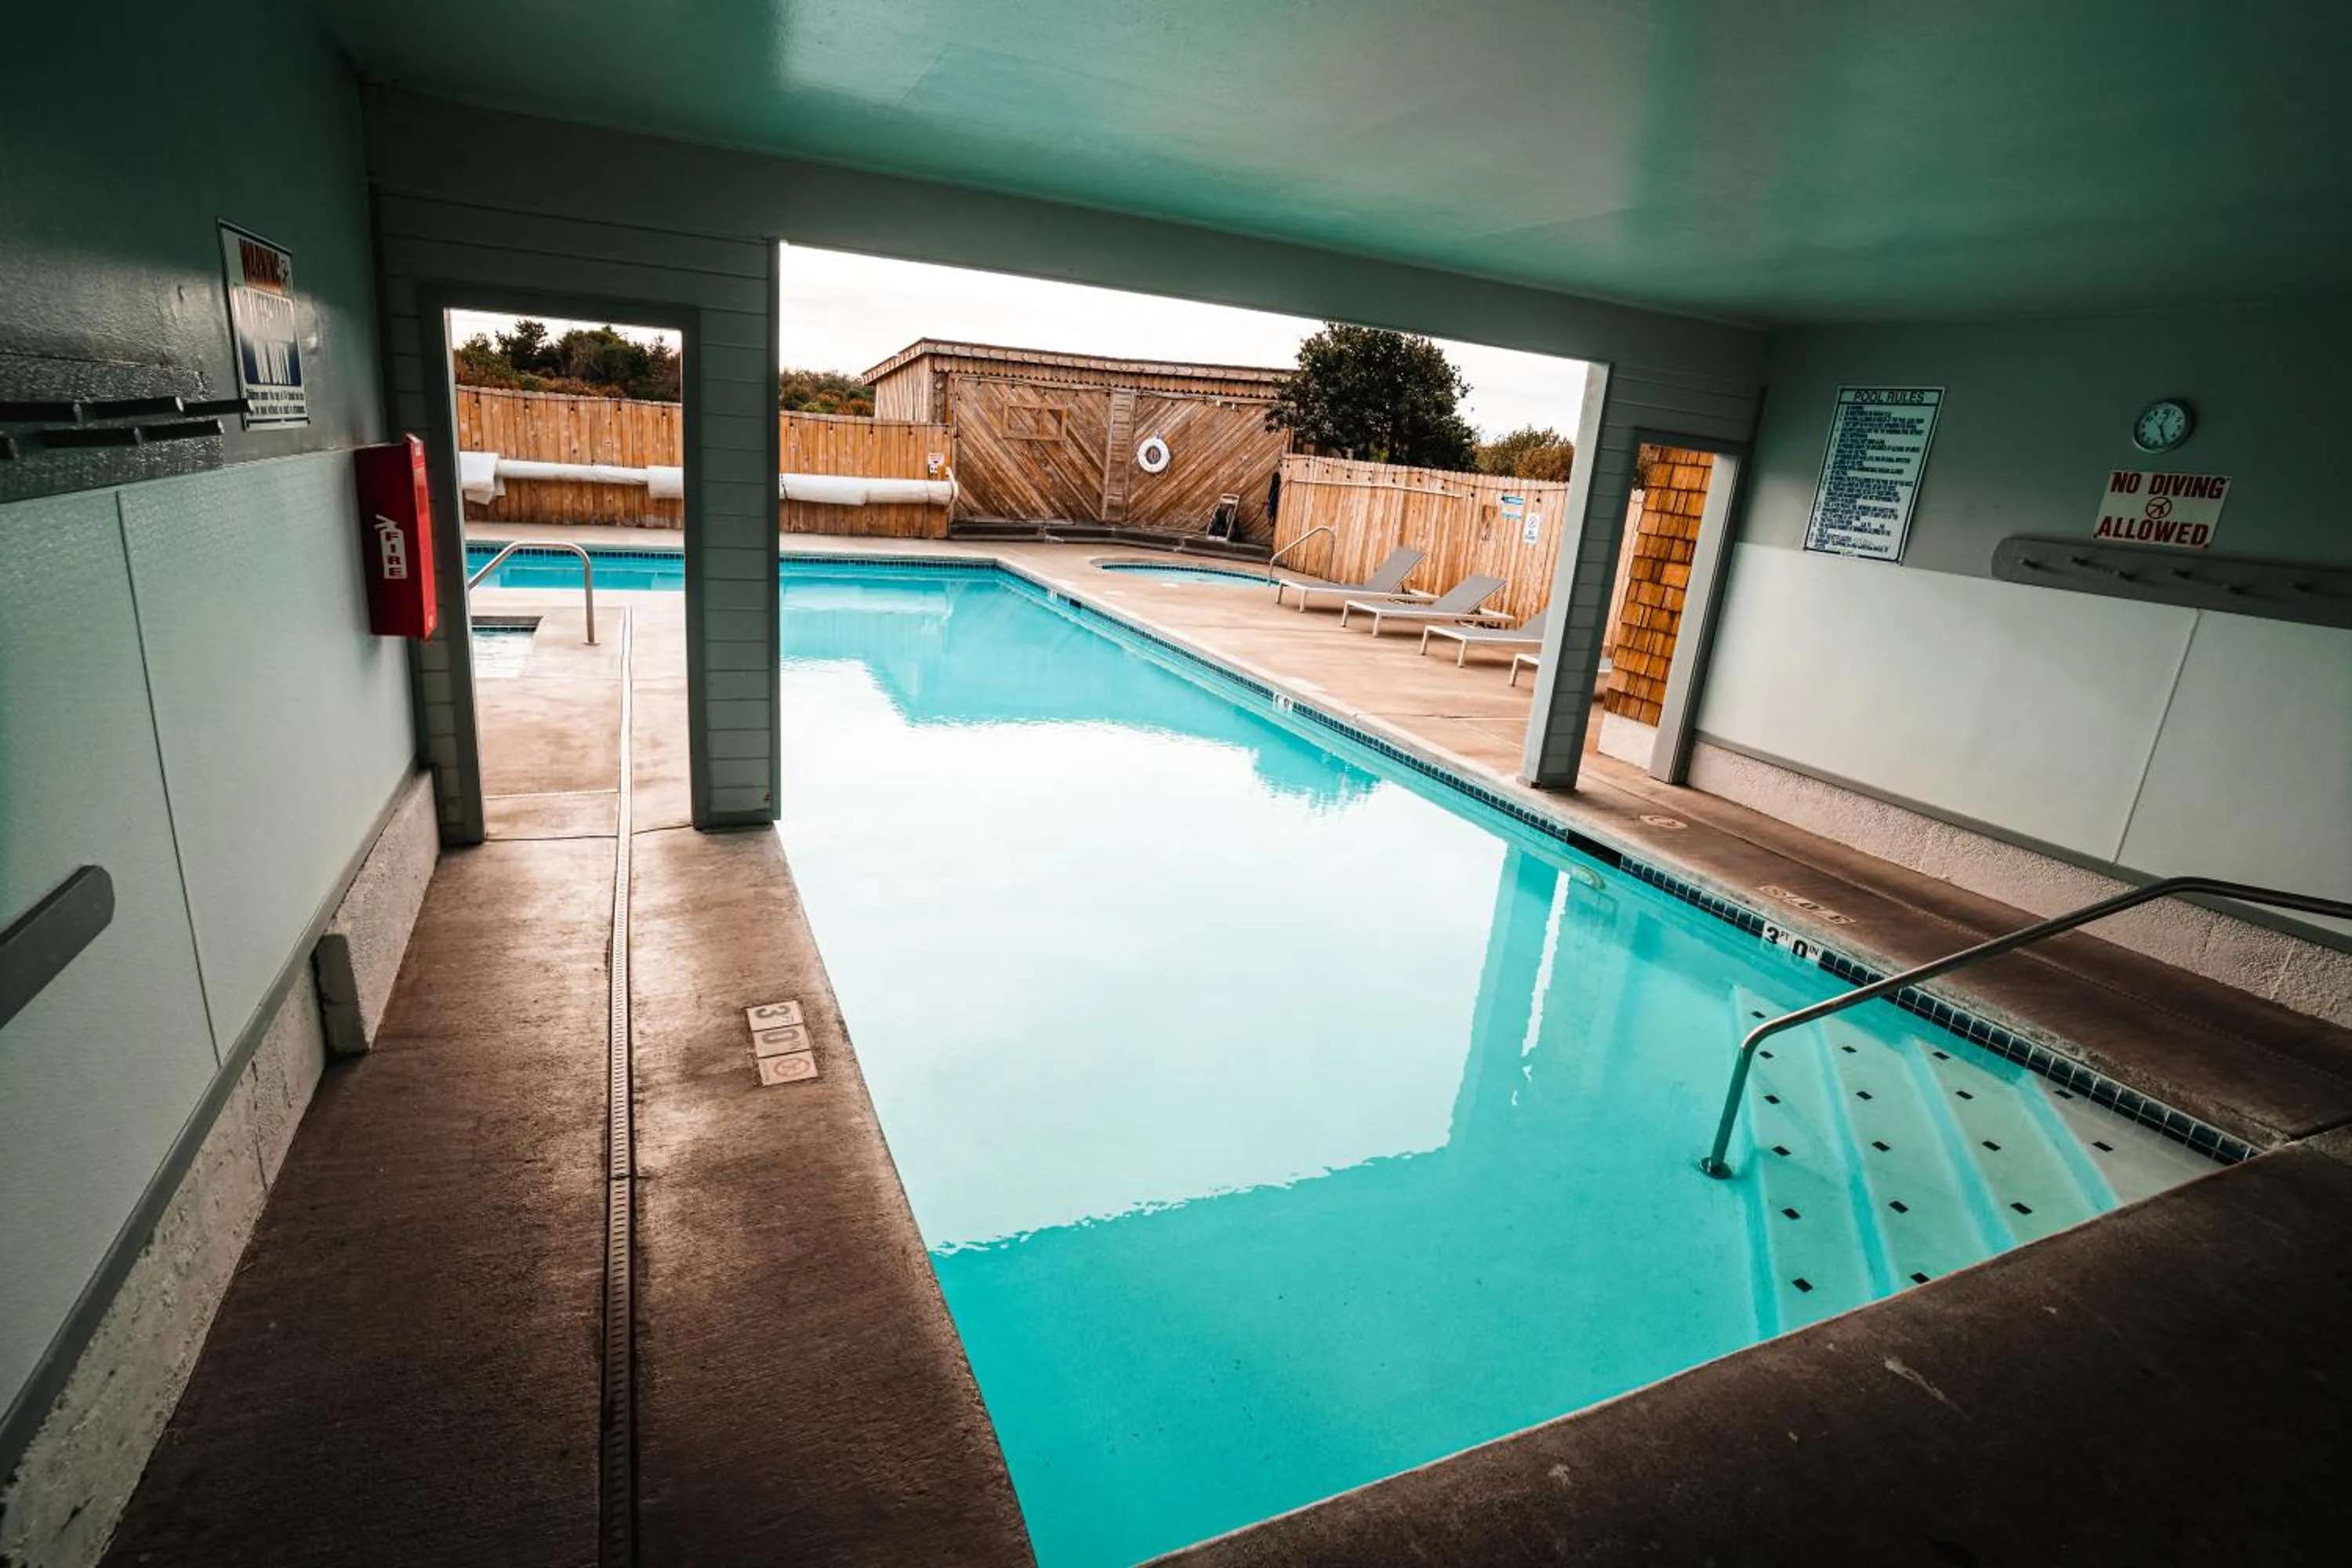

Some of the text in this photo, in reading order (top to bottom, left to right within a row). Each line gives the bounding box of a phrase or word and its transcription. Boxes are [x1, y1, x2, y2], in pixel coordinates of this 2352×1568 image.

[1853, 391, 1926, 403] POOL RULES
[2110, 472, 2226, 499] NO DIVING
[2097, 516, 2209, 545] ALLOWED
[385, 532, 402, 576] FIRE
[1766, 926, 1780, 945] 3
[1780, 931, 1790, 942] FT
[1792, 938, 1809, 958] 0
[754, 1004, 791, 1019] 3
[761, 1028, 800, 1045] 0
